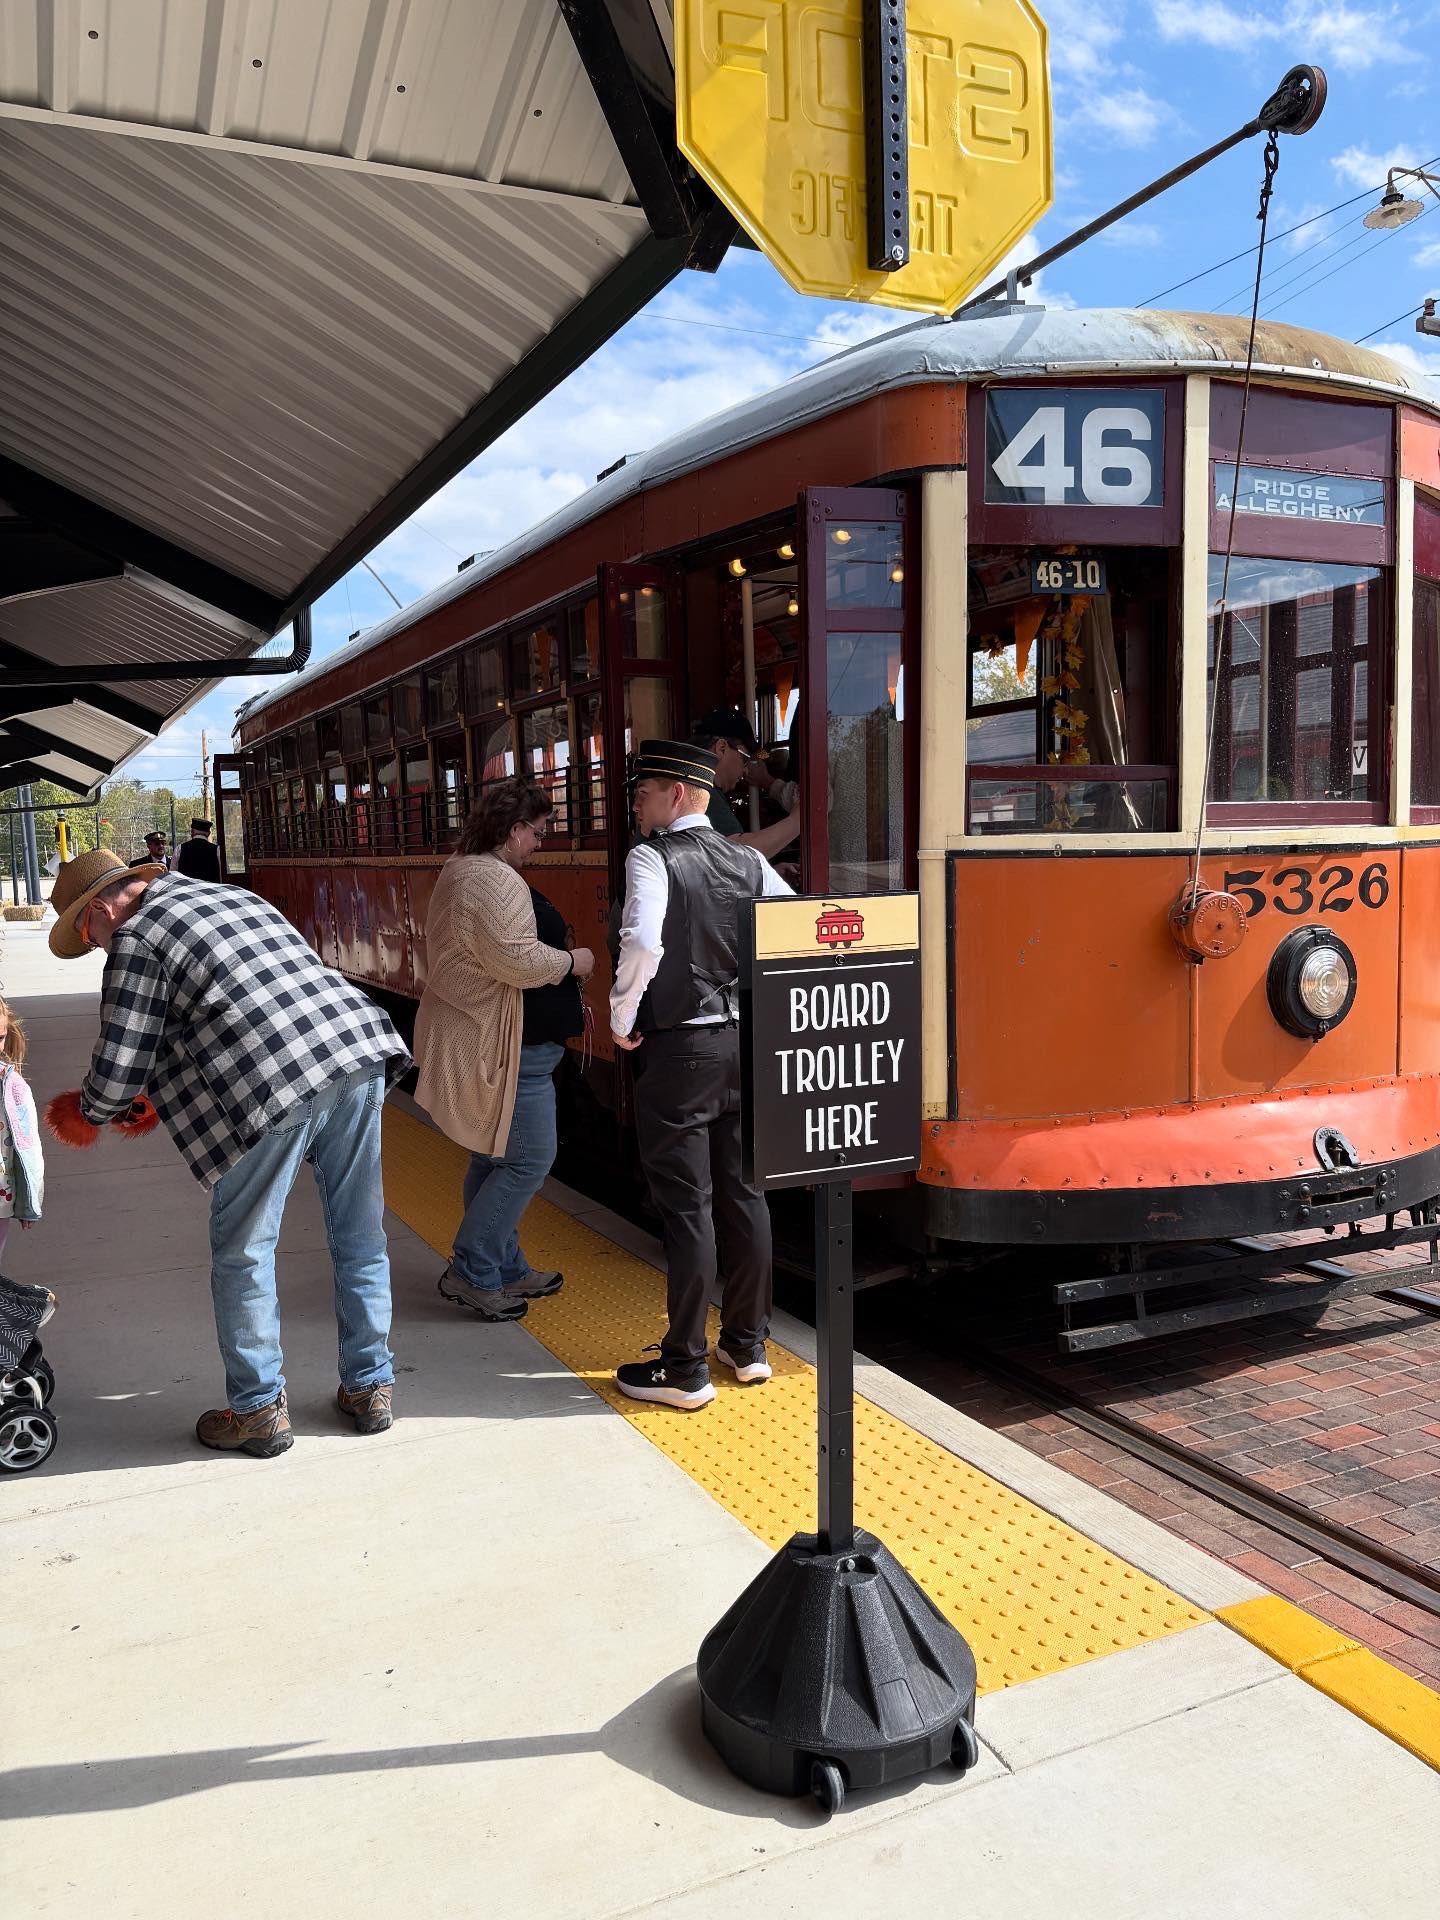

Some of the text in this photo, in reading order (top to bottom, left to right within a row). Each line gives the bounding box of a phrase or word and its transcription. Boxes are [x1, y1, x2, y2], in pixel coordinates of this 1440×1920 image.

[991, 406, 1153, 506] 46
[1254, 479, 1331, 501] RIDGE
[1036, 560, 1101, 589] 46-10
[1223, 862, 1390, 918] 5326
[790, 981, 890, 1033] BOARD
[775, 1038, 905, 1095] TROLLEY
[805, 1101, 879, 1153] HERE
